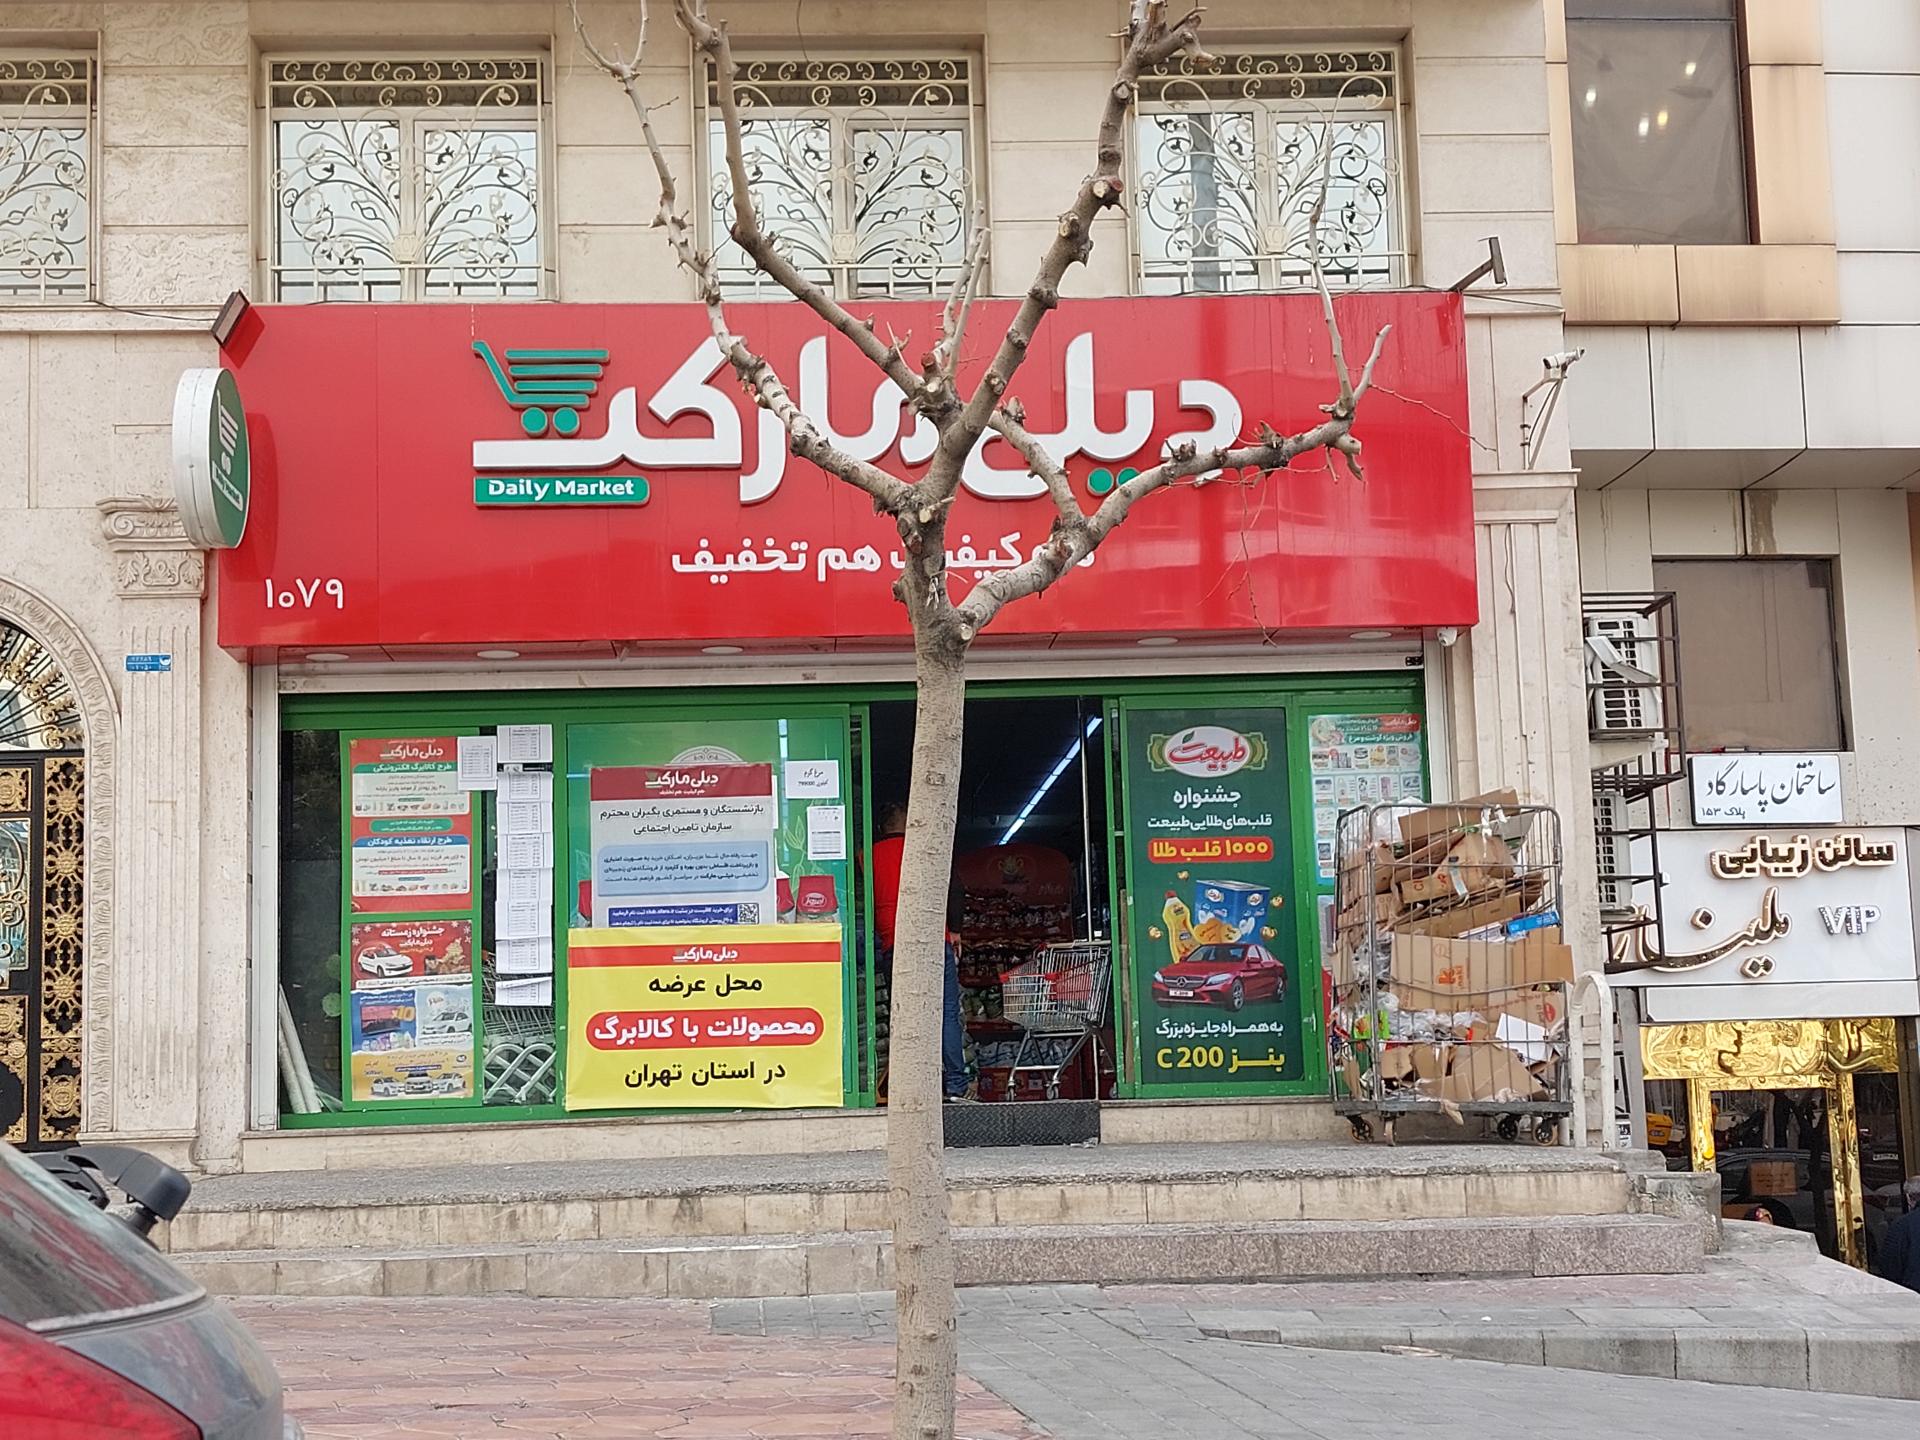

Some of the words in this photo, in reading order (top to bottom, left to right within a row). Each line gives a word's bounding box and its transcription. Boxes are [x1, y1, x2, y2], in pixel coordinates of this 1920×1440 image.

[488, 479, 549, 501] Daily
[554, 479, 635, 498] Market
[672, 537, 808, 584] تخفیف
[817, 545, 882, 582] هم
[1168, 736, 1247, 771] طبیعت
[645, 770, 690, 788] مارکت
[690, 770, 719, 788] دیلی
[1706, 760, 1768, 813] پاسارگاد
[1771, 760, 1836, 805] ساختمان
[1173, 785, 1242, 809] جشنواره
[600, 809, 630, 820] محترم
[632, 806, 660, 819] بگیران
[663, 807, 701, 818] مستمری
[704, 808, 708, 816] و
[710, 804, 763, 816] بازنشستگان
[1701, 807, 1721, 816] ۱۵۳
[1724, 806, 1746, 819] پلاک
[633, 824, 671, 836] اجتماعی
[673, 824, 699, 835] تامین
[701, 822, 732, 833] سازمان
[1153, 841, 1178, 858] طلا
[1180, 840, 1222, 861] قلب
[1710, 834, 1812, 879] زیبایی
[1815, 834, 1897, 872] سالن
[1818, 904, 1882, 936] VIP
[672, 946, 713, 963] مارکت
[713, 946, 738, 961] دیلی
[649, 974, 706, 999] عرضه
[715, 974, 763, 997] محل
[594, 1015, 675, 1046] کالابرگ
[683, 1016, 699, 1043] با
[707, 1015, 816, 1042] محصولات
[1156, 1018, 1184, 1039] بزرگ
[1228, 1046, 1285, 1073] بنز
[625, 1063, 683, 1088] تهران
[691, 1061, 755, 1086] استان
[763, 1062, 786, 1084] در
